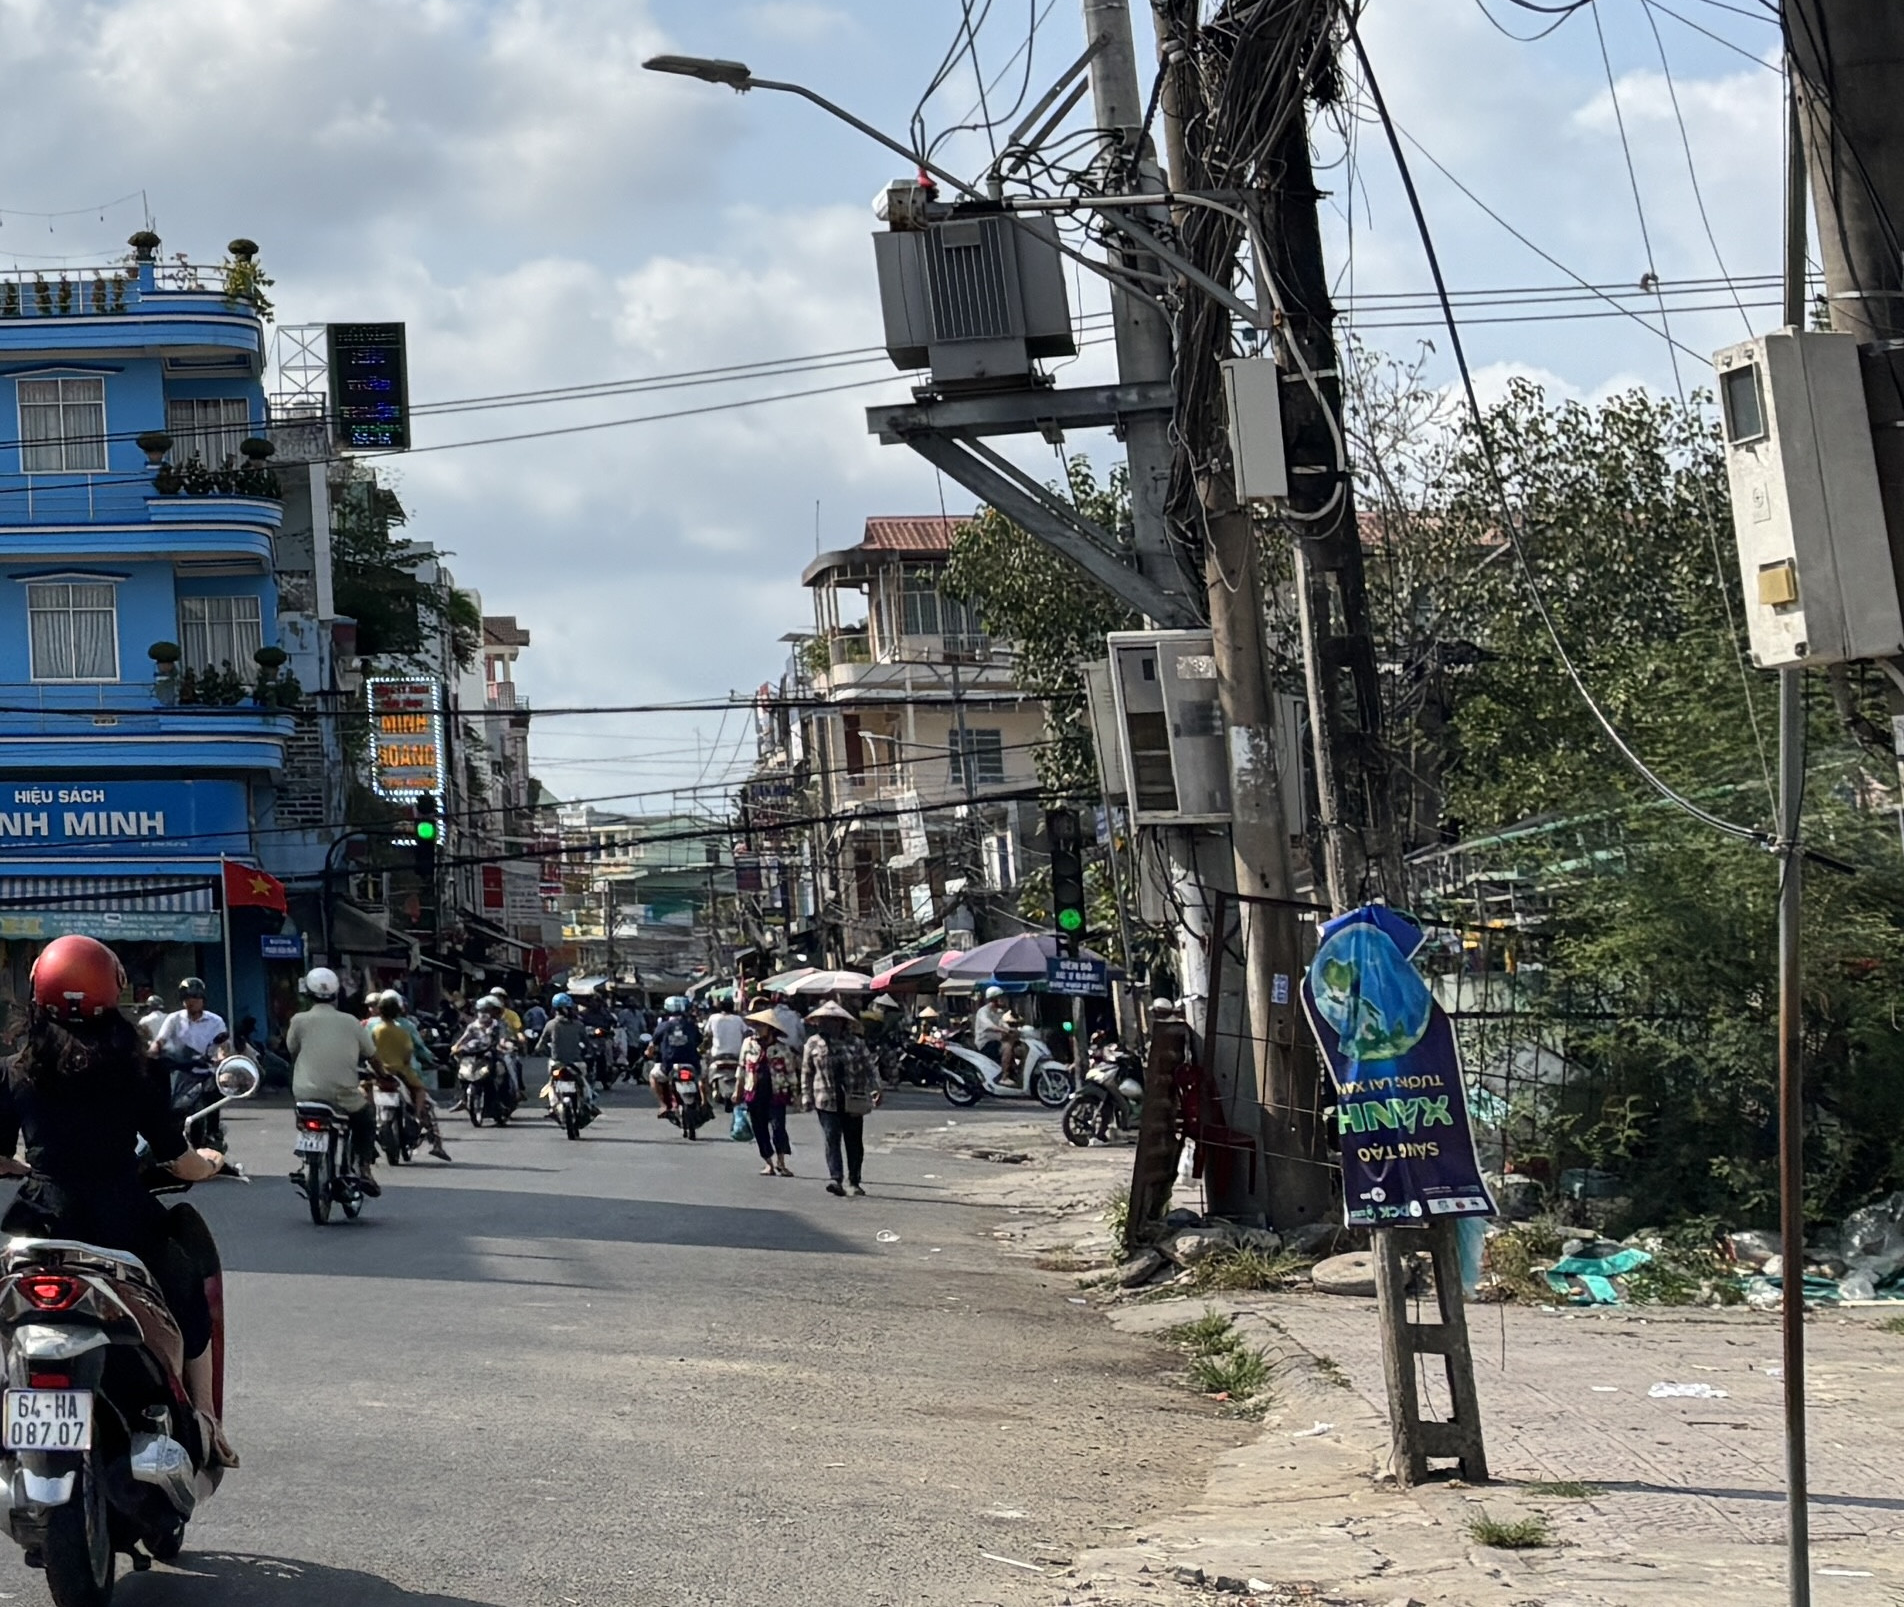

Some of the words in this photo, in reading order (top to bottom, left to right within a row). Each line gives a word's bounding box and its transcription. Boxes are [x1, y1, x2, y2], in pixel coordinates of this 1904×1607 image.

[14, 786, 53, 806] HIỆU
[58, 786, 105, 803] SÁCH
[63, 811, 166, 836] MINH
[1336, 1080, 1365, 1095] XAN
[1369, 1078, 1393, 1092] LAI
[1337, 1095, 1454, 1134] XANH
[1358, 1142, 1398, 1162] TẠO
[1399, 1141, 1440, 1160] SÁNG
[18, 1394, 78, 1419] 64-HA
[11, 1421, 84, 1446] 087.07
